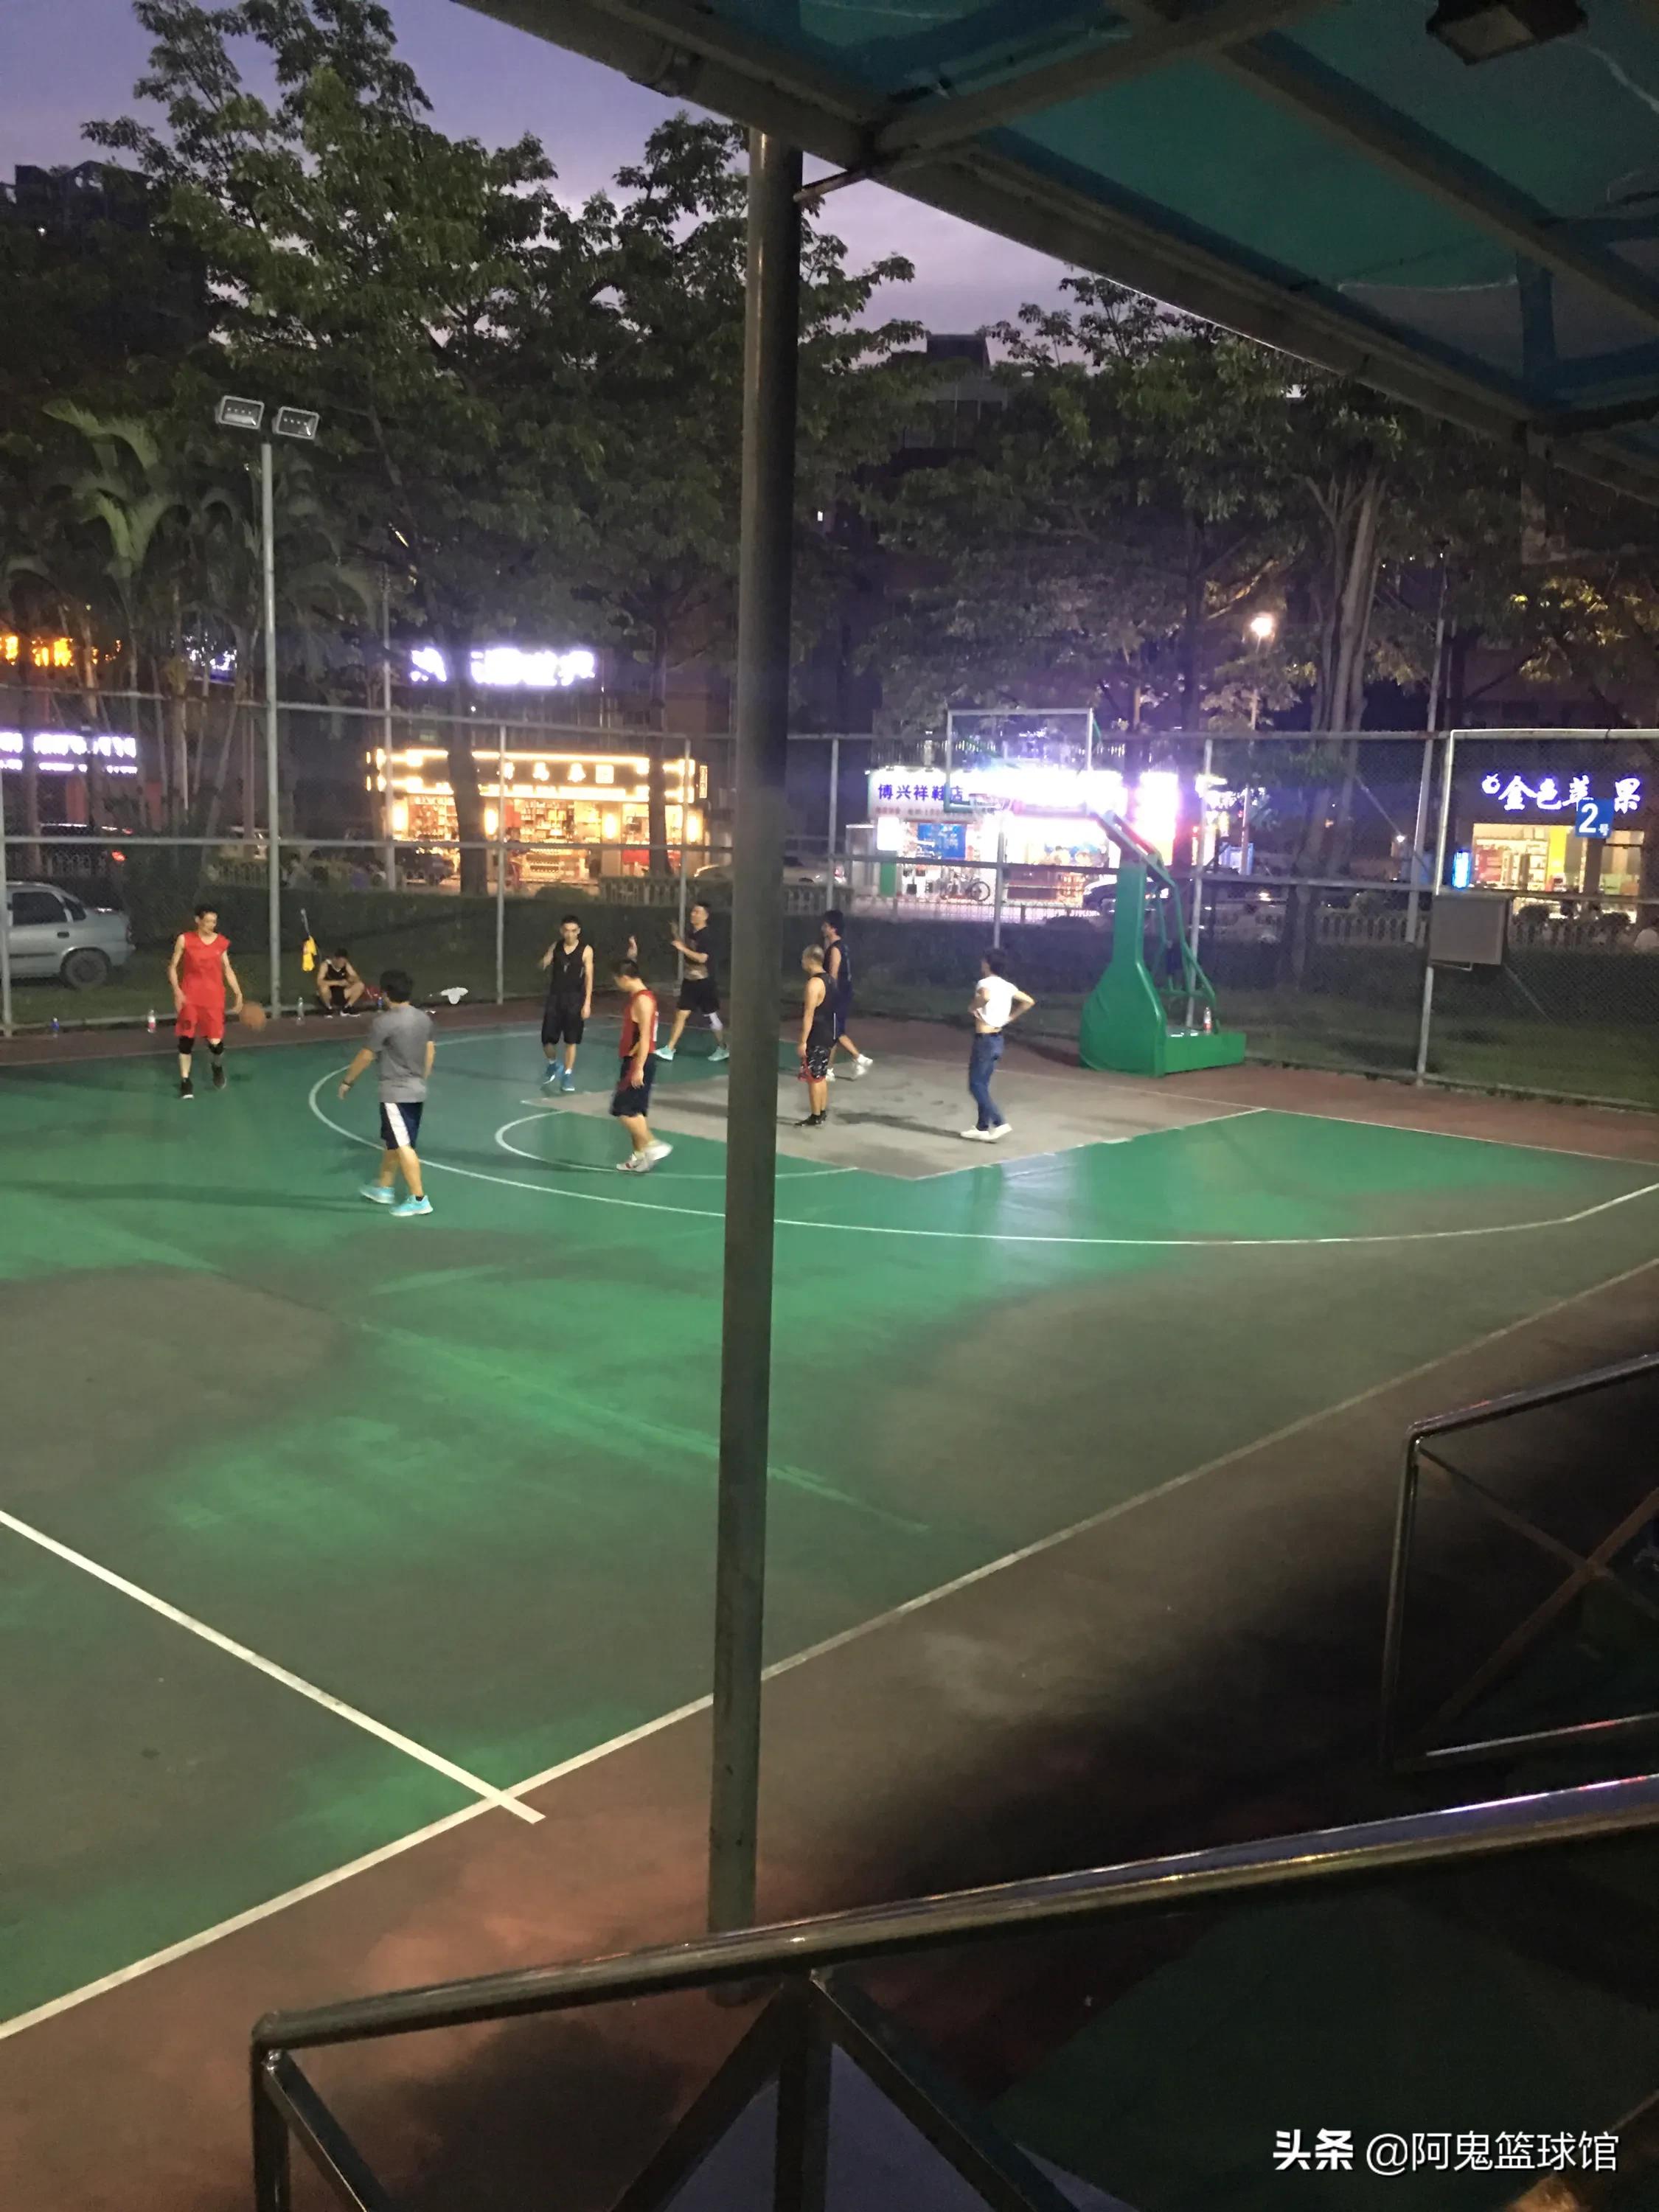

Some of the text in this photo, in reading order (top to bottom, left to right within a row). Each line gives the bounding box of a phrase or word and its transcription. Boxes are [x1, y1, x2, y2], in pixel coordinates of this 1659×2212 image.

[878, 784, 964, 801] 博兴祥鞋店
[1578, 802, 1610, 836] 2号
